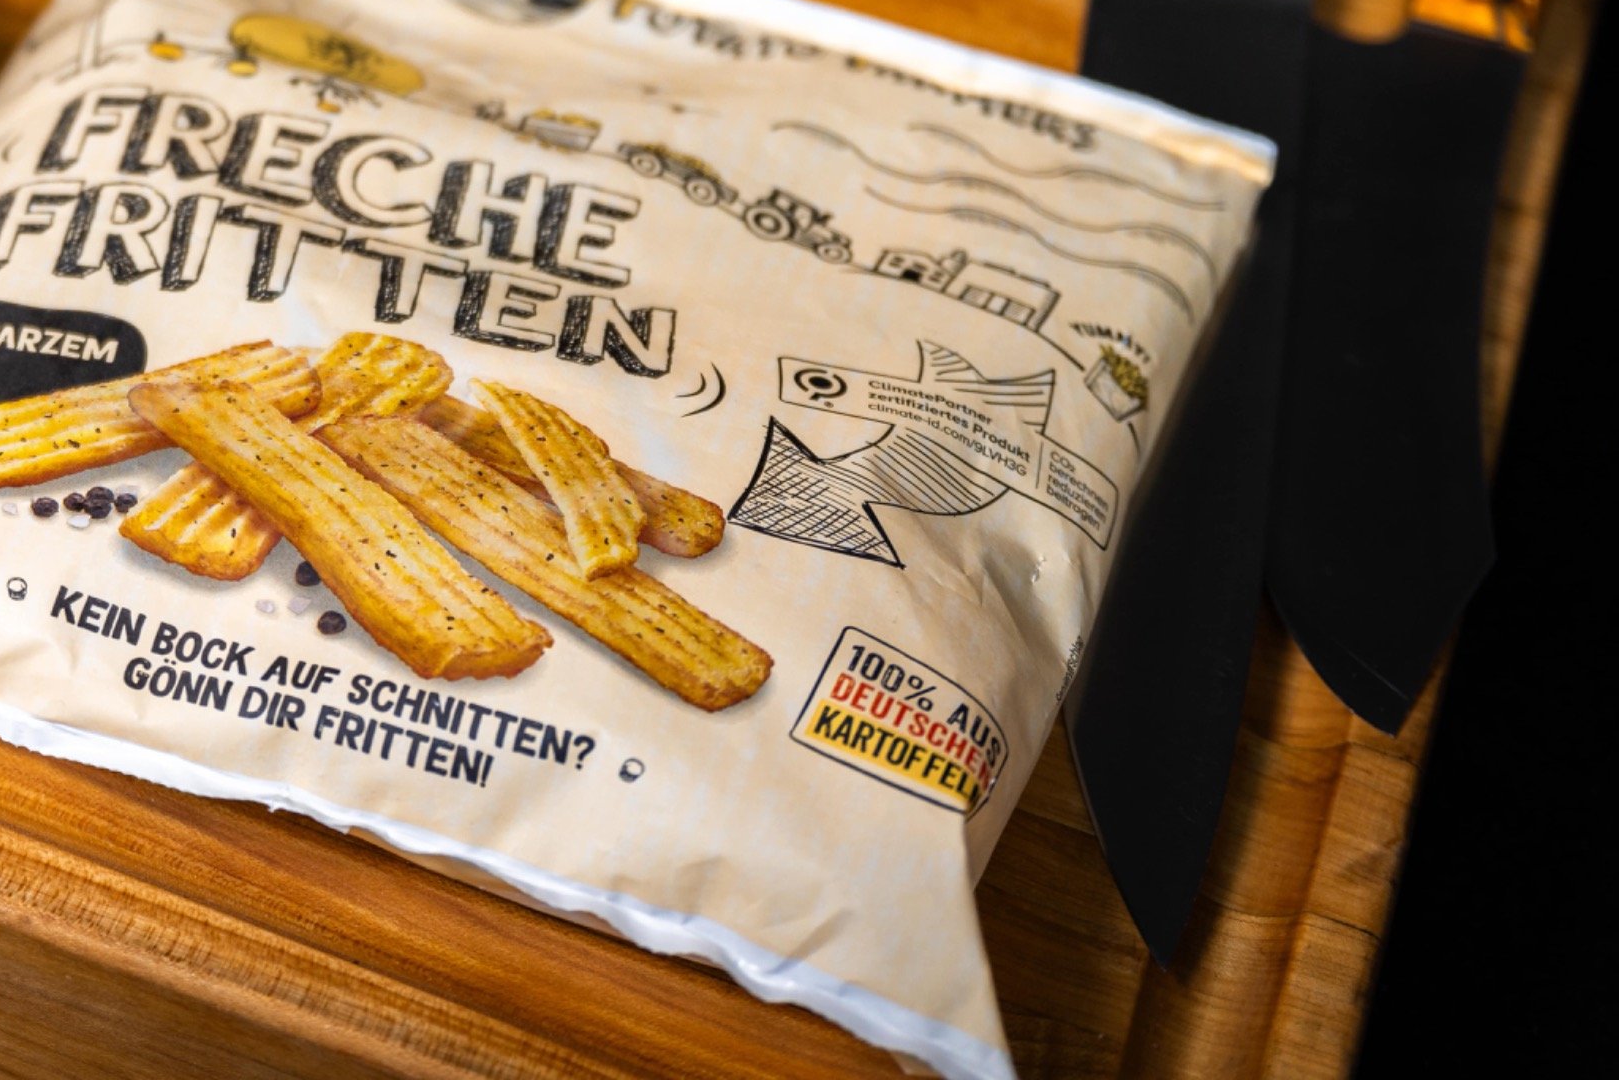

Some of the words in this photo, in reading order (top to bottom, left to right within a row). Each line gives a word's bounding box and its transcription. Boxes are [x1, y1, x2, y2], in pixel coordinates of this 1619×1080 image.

[36, 83, 642, 290] FRECHE
[868, 380, 993, 425] ClimatePartner
[868, 391, 969, 429] zertifiziertes
[973, 422, 1031, 463] Produkt
[50, 585, 147, 647] KEIN
[151, 622, 256, 678] BOCK
[261, 654, 342, 695] AUF
[347, 674, 597, 771] SCHNITTEN?
[122, 656, 234, 713] GÖNN
[239, 685, 307, 732] DIR
[313, 706, 495, 789] FRITTEN!
[830, 672, 992, 791] DEUTSCHEN
[847, 644, 937, 712] 100%
[946, 702, 1002, 768] AUS
